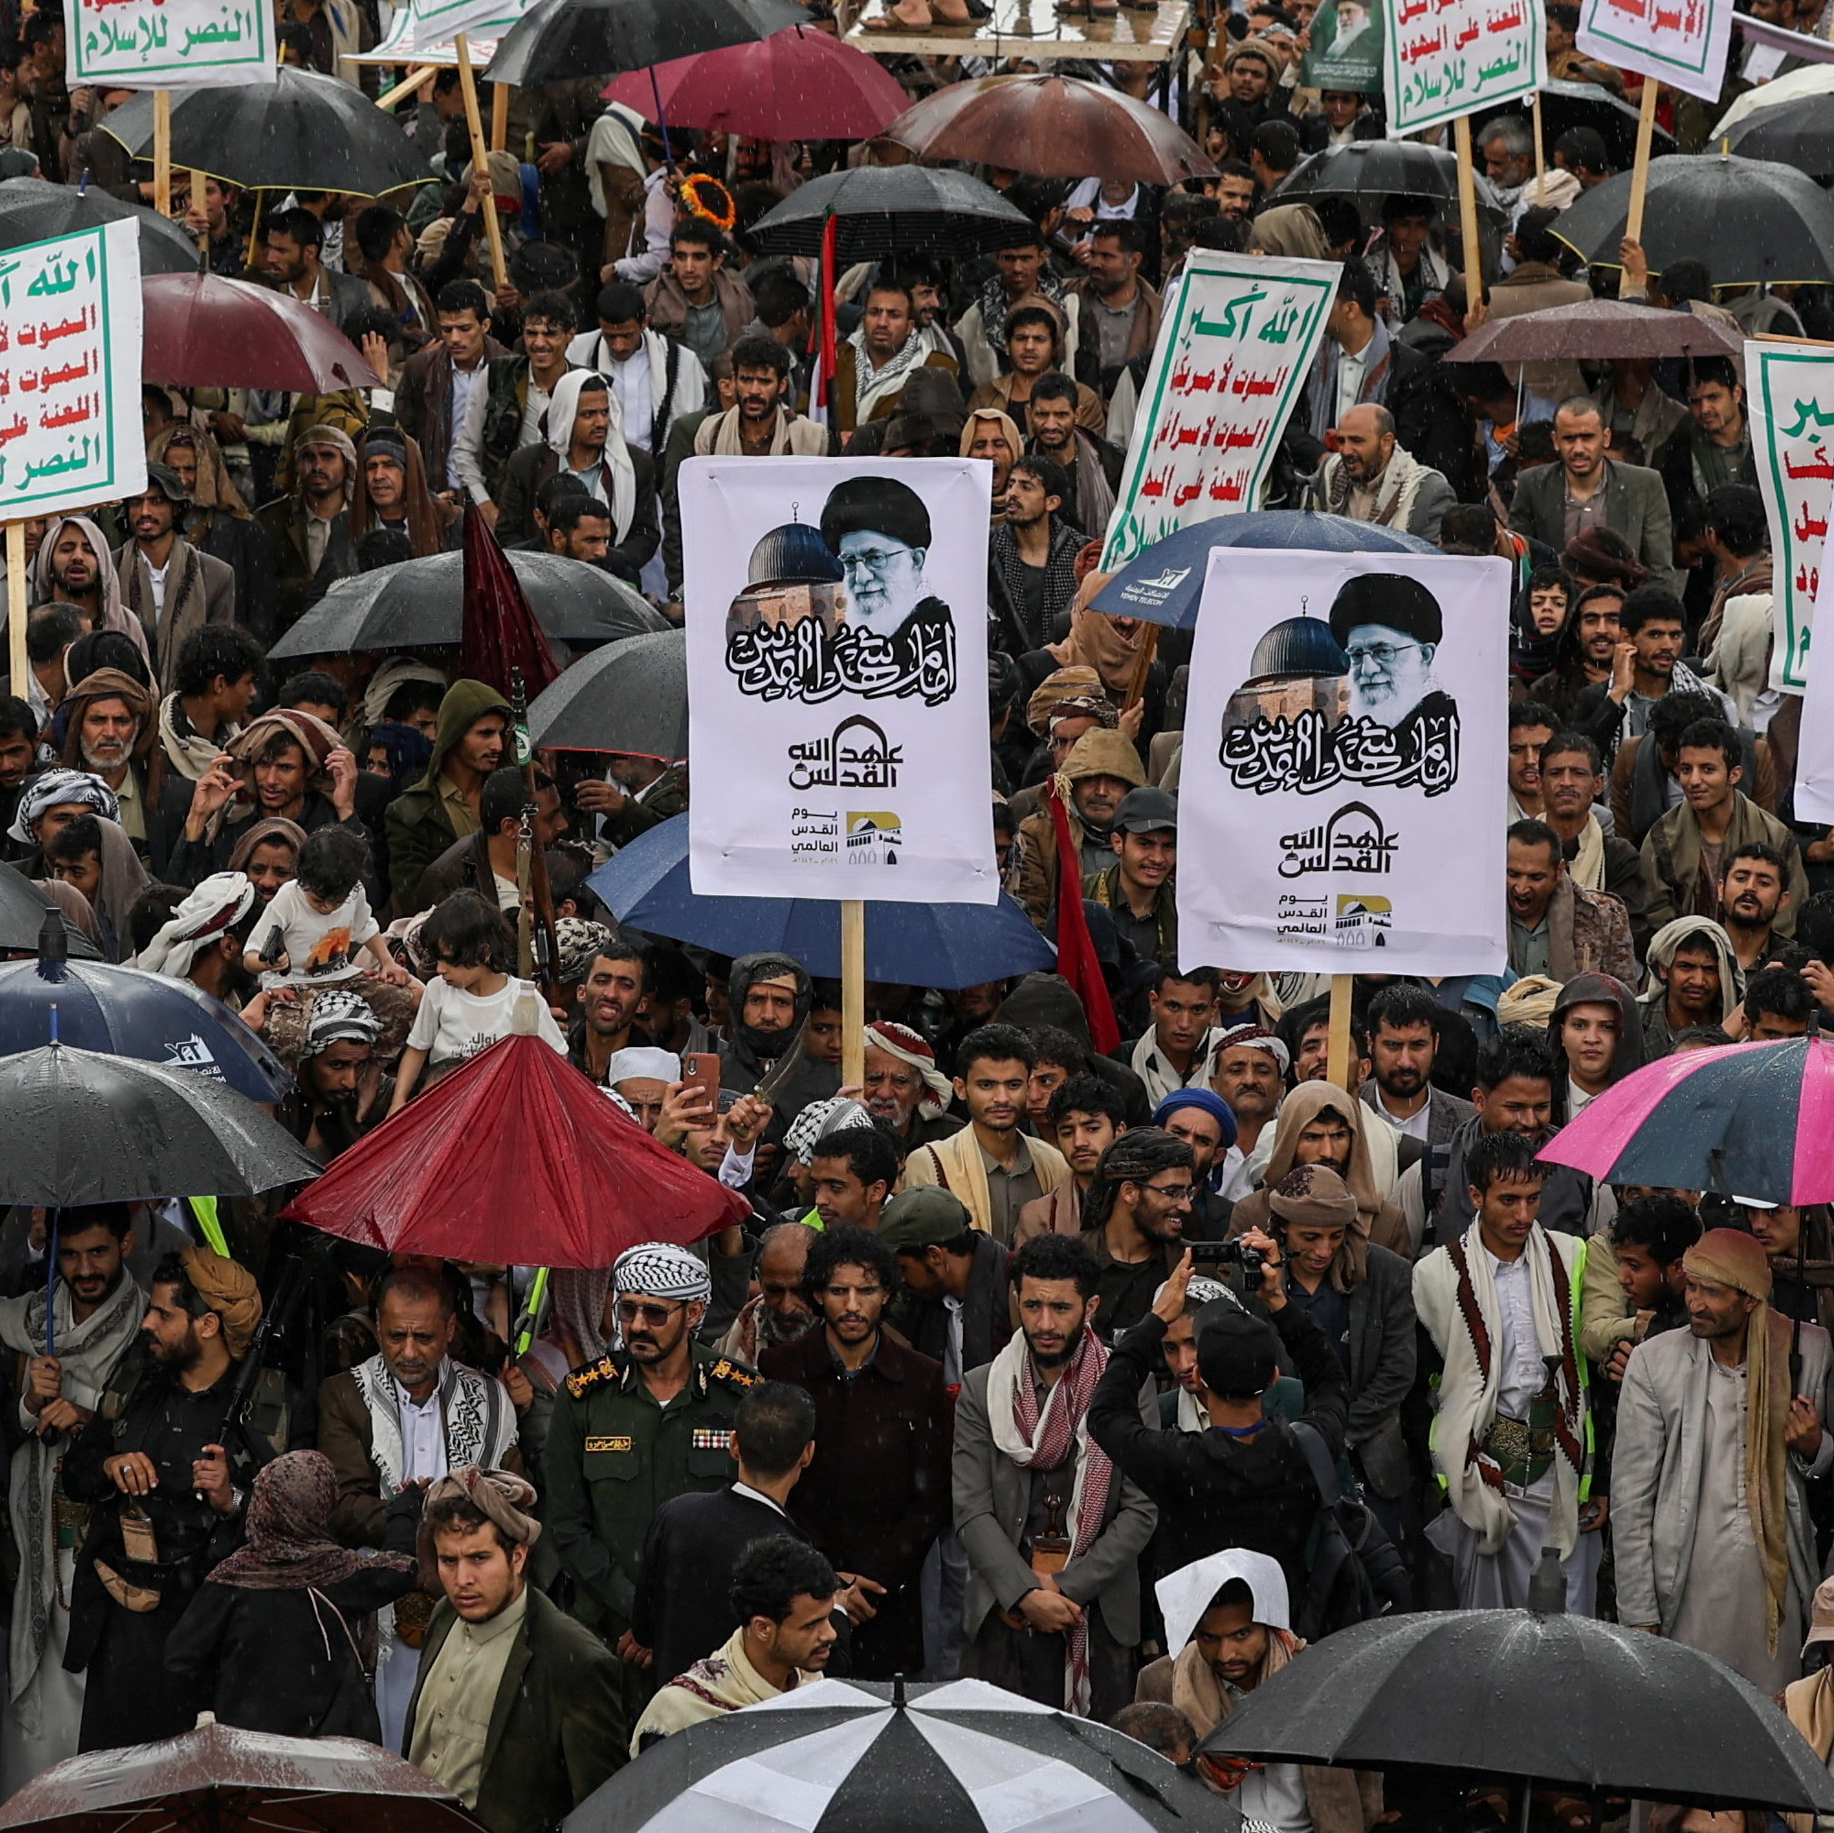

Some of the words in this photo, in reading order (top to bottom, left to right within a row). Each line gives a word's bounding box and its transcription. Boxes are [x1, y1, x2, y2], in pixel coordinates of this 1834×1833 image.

[27, 249, 96, 296] الله
[16, 305, 97, 350] الموت
[19, 349, 98, 393] الموت
[39, 393, 100, 429] اللعنة
[16, 436, 100, 490] النصر
[1120, 592, 1138, 602] YEMEN
[1138, 596, 1165, 606] TELECOM
[791, 806, 838, 820] يوم
[791, 824, 838, 836] القدس
[791, 840, 838, 853] العالمي
